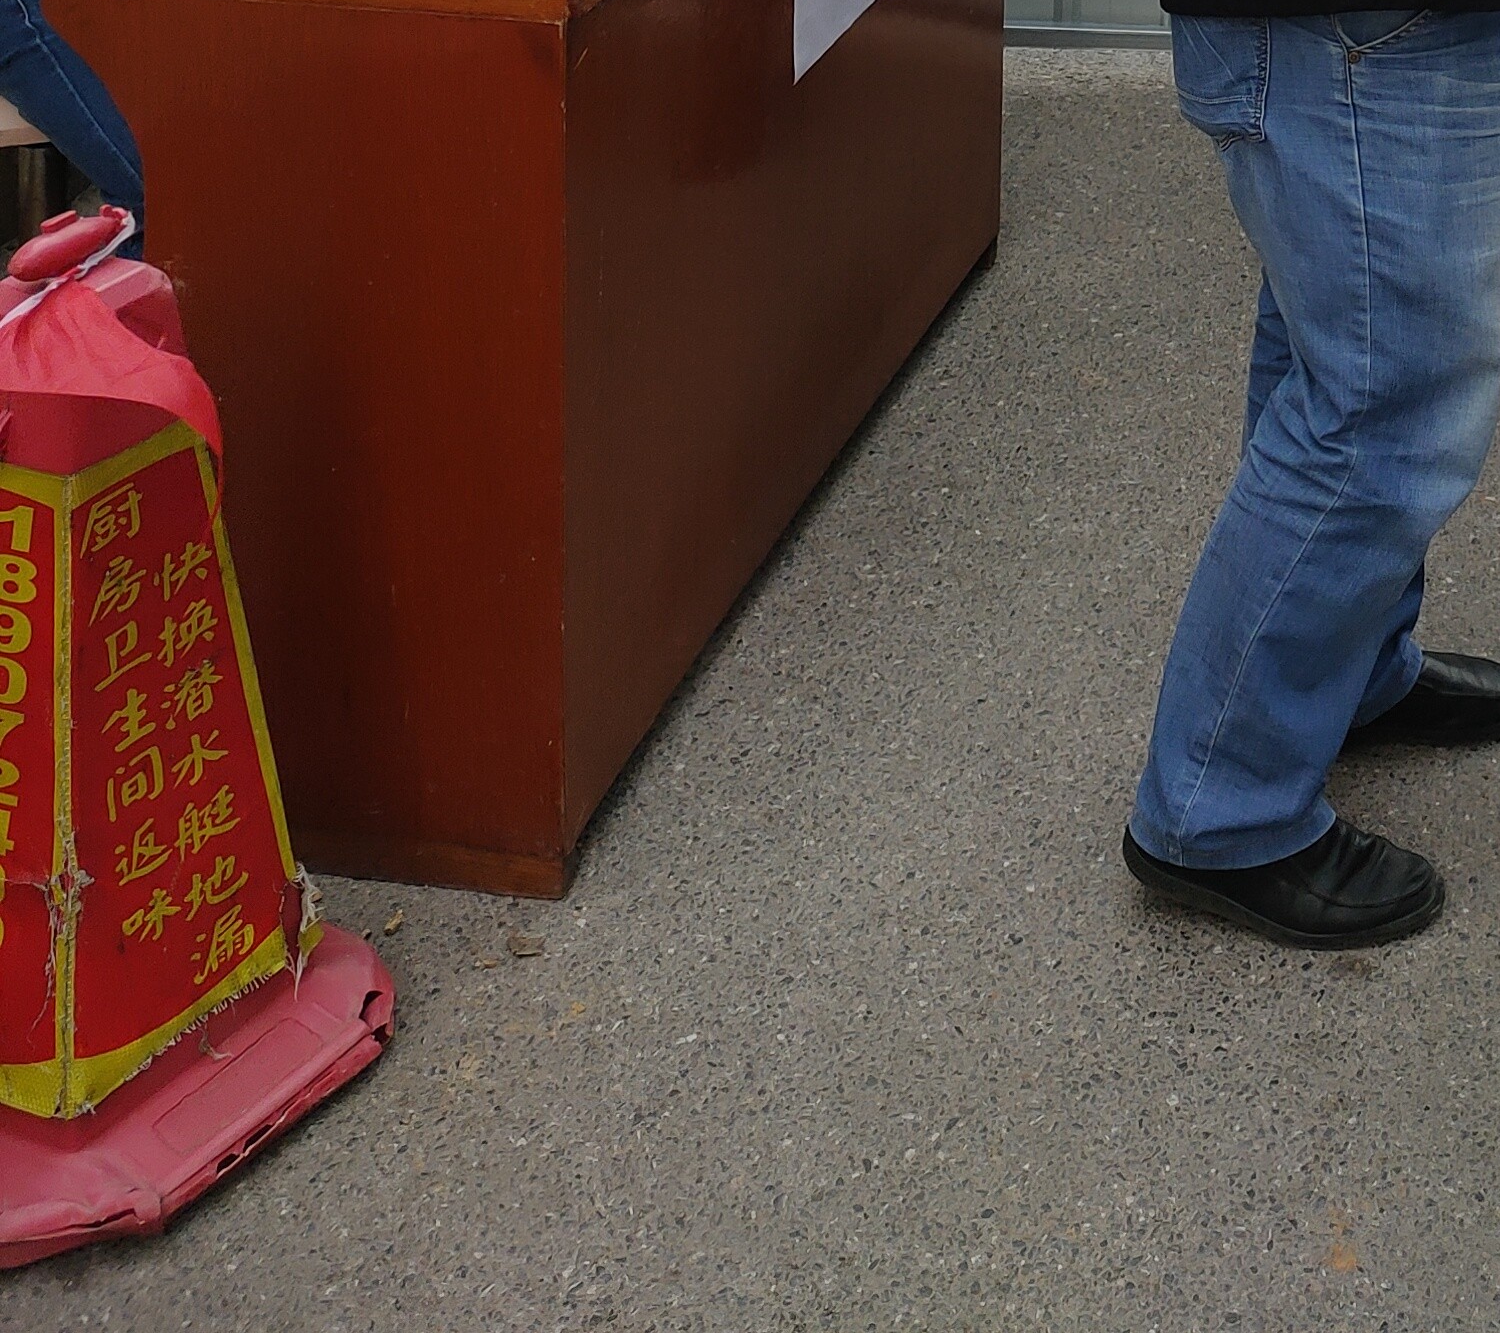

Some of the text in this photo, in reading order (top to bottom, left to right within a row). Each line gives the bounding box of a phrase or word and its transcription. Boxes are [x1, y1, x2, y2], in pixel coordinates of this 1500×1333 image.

[80, 482, 181, 942] 厨房卫生间返味
[154, 541, 254, 985] 快换潜水艇地漏
